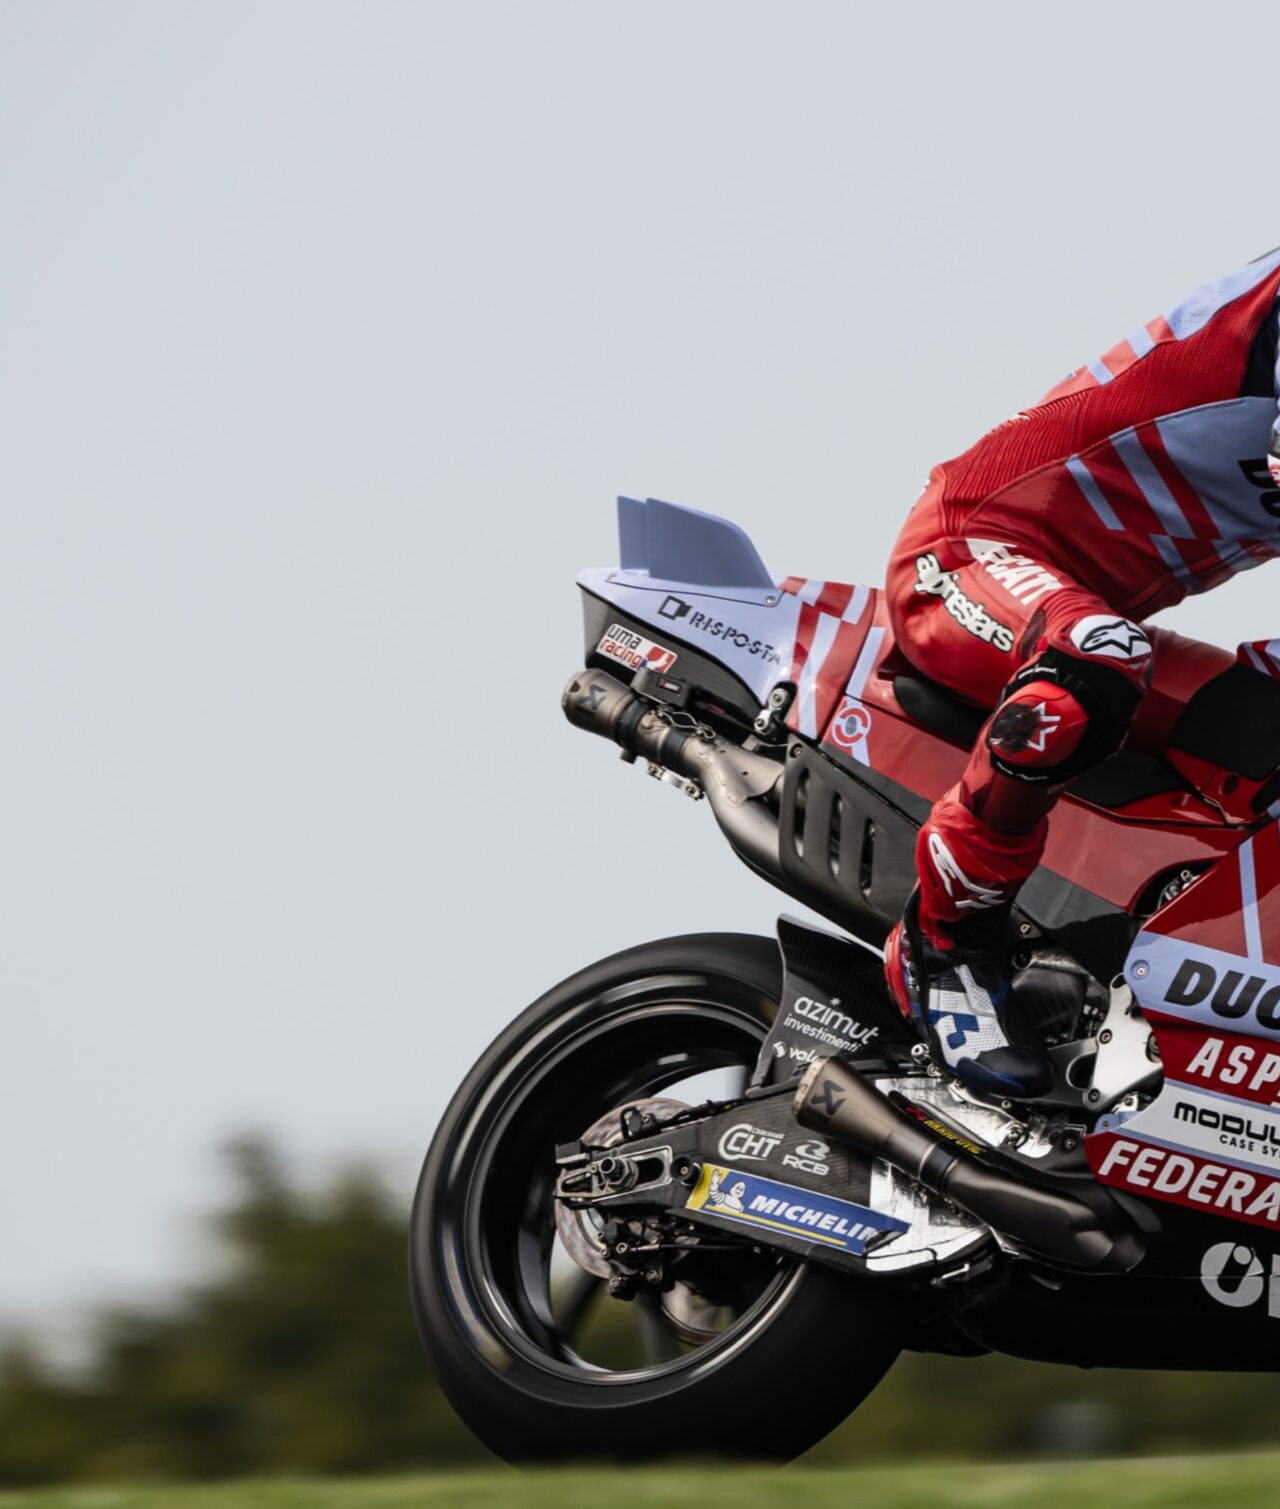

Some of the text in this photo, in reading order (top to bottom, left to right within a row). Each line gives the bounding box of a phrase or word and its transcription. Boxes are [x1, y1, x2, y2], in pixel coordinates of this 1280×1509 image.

[965, 537, 1064, 606] CATI
[599, 638, 643, 671] racing
[606, 625, 643, 650] uma
[783, 1012, 863, 1054] investimenti
[793, 996, 880, 1046] azimut
[1219, 1133, 1256, 1152] CASE
[781, 1153, 830, 1177] RCB
[747, 1194, 881, 1242] MICHELIN
